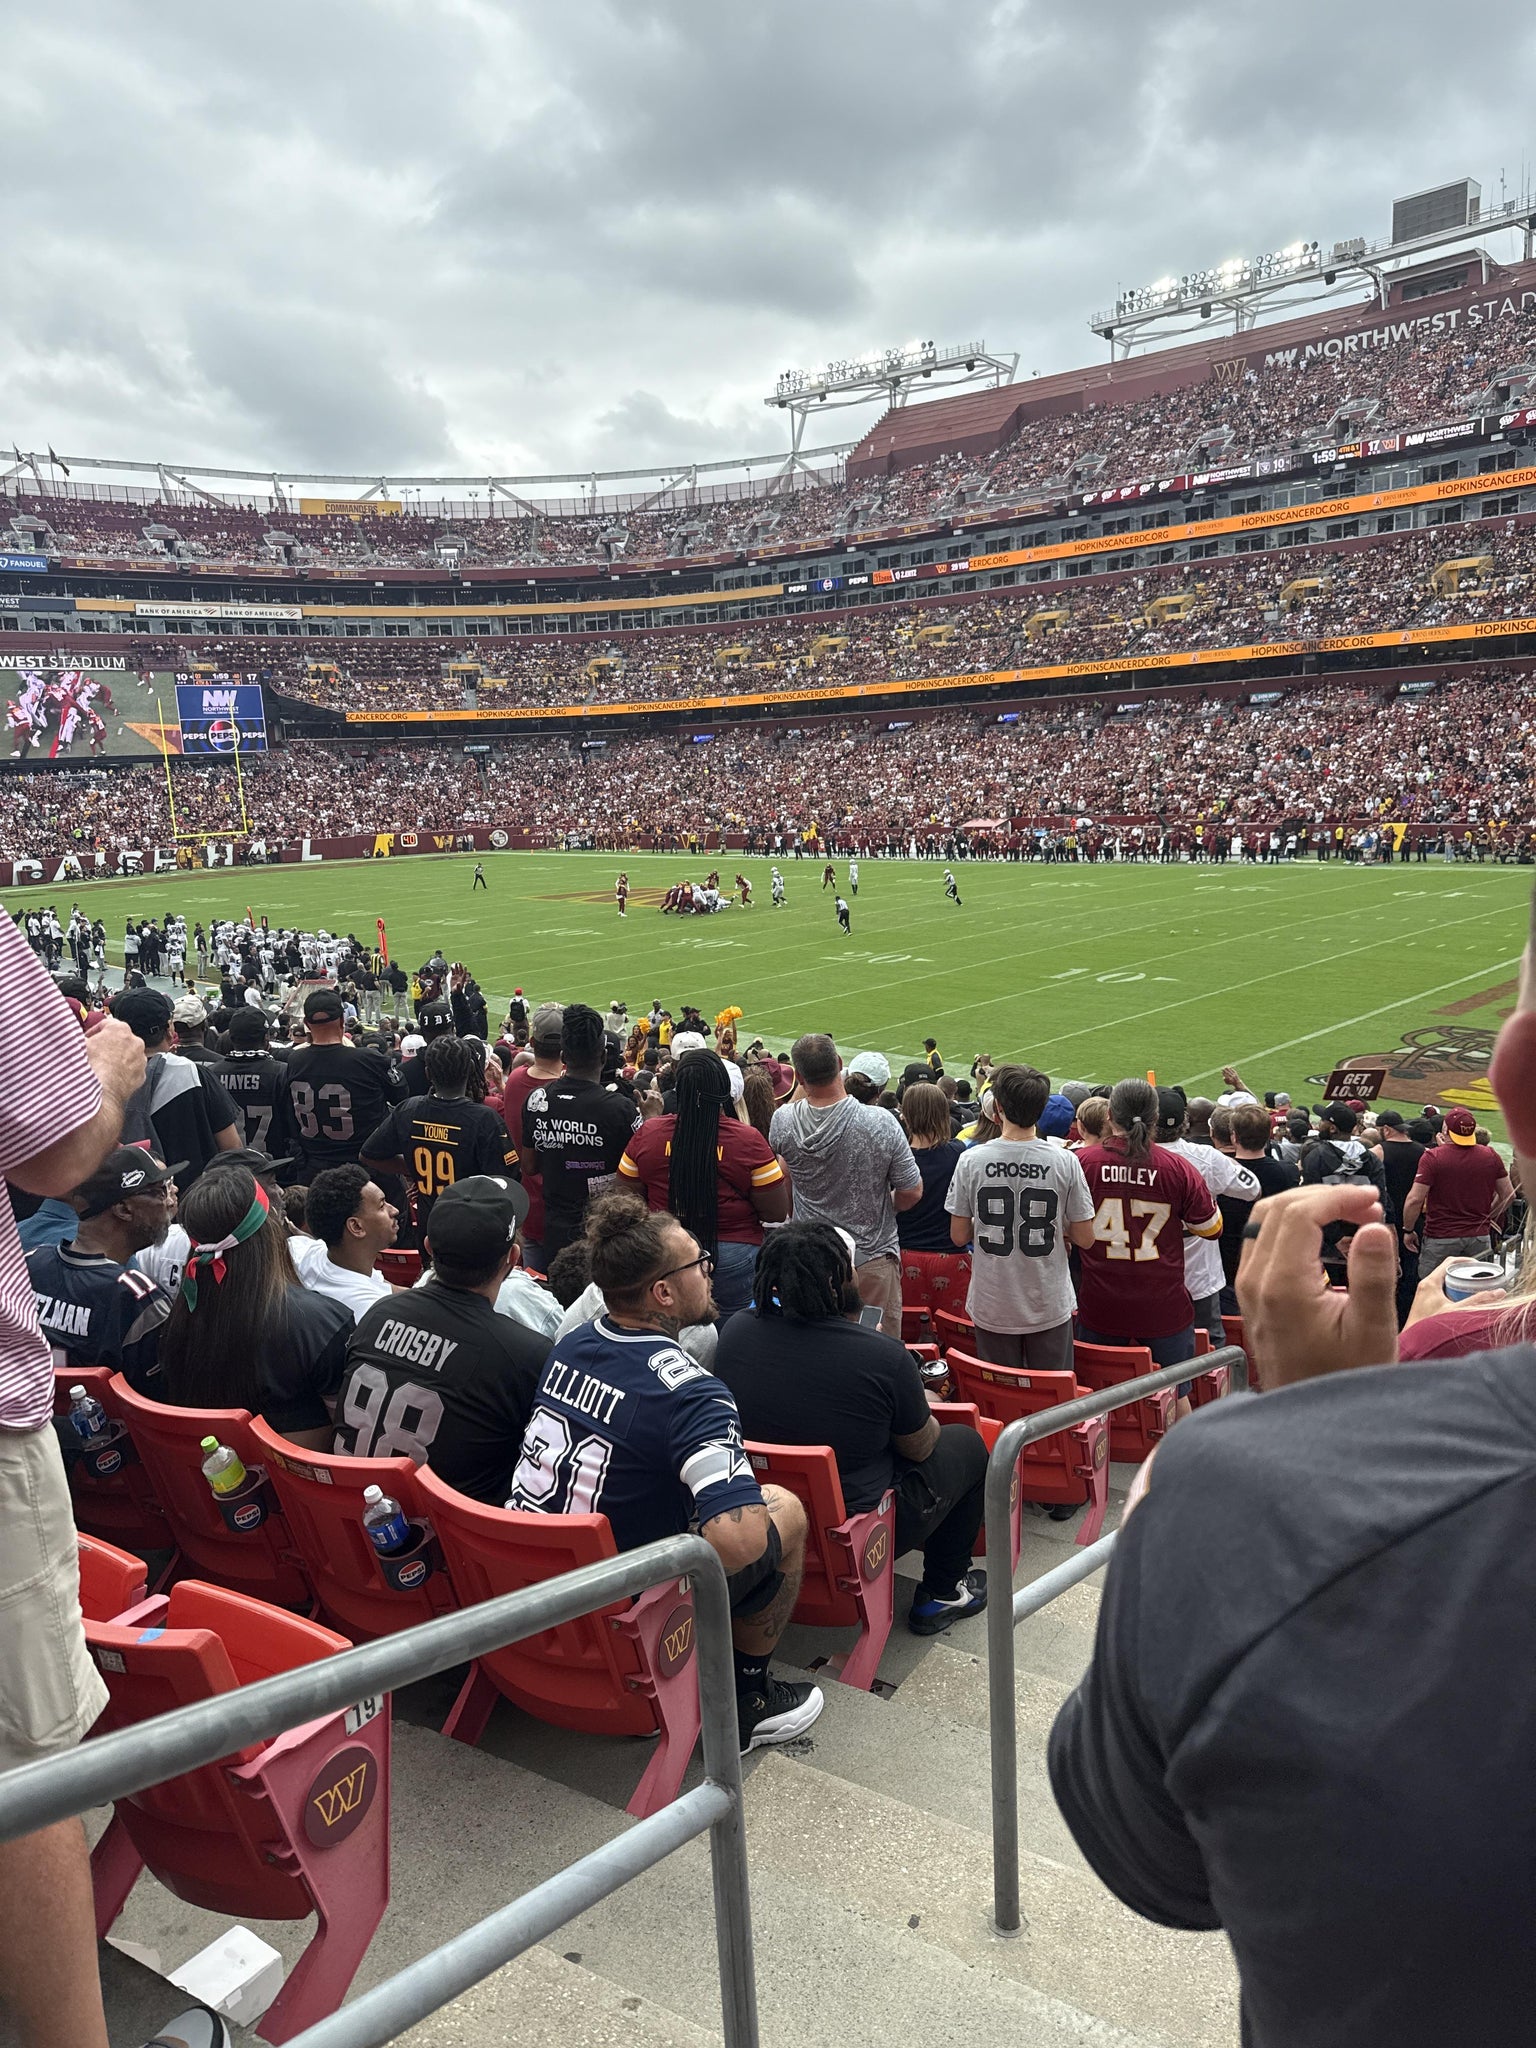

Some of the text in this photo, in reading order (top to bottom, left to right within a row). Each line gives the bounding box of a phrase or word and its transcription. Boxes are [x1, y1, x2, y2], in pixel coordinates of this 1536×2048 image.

[1305, 309, 1461, 359] NORTHWEST
[1426, 422, 1475, 438] NORTHWEST
[1368, 440, 1380, 451] 17
[1273, 458, 1285, 469] 10
[1312, 449, 1336, 464] 1:59
[1210, 465, 1252, 478] NORTHWEST
[325, 503, 378, 515] COMMANDERS
[1241, 501, 1350, 526] HOPKINSCANCERDC.ORG
[1074, 530, 1169, 552] HOPKINSCANCERDC.ORG
[10, 560, 46, 568] FANDUEL
[788, 584, 807, 593] PEPSI
[848, 576, 868, 585] PEPSI
[1475, 619, 1536, 636] HOPKINSC
[49, 657, 126, 668] STADIUM
[1067, 656, 1171, 675] HOPKINSCANCERDC.ORG
[905, 674, 995, 690] HOPKINSCANCERDC.ORG
[202, 690, 237, 706] NW
[763, 688, 845, 702] HOPKINSCANCERDC.ORG
[476, 708, 567, 718] HOPKINSCANCERDC.ORG
[627, 700, 706, 712] HOPKINSCANCERDC.ORG
[346, 712, 408, 721] SCANCERDC.ORG
[183, 732, 207, 740] PEPSI
[210, 732, 239, 740] PEPSI
[242, 731, 265, 739] PEPSI
[220, 1075, 261, 1090] HAYES
[1343, 1073, 1371, 1085] GET
[290, 1081, 355, 1140] 83
[424, 1125, 449, 1140] YOUNG
[536, 1118, 597, 1135] 3x WORLD
[533, 1130, 604, 1147] CHAMPIONS
[414, 1146, 455, 1196] 99
[985, 1162, 1050, 1180] CROSBY
[1101, 1165, 1158, 1187] COOLEY
[1237, 1170, 1254, 1186] 9
[977, 1185, 1059, 1258] 98
[1092, 1198, 1171, 1262] 47
[117, 1269, 157, 1300] 11
[374, 1319, 459, 1372] CROSBY
[542, 1360, 626, 1425] ELLIOTT
[333, 1363, 445, 1467] 98
[98, 1453, 120, 1467] PEPSI
[504, 1405, 614, 1514] 21
[235, 1509, 260, 1523] PEPSI
[400, 1565, 425, 1580] PEPSI
[352, 1697, 375, 1727] 19
